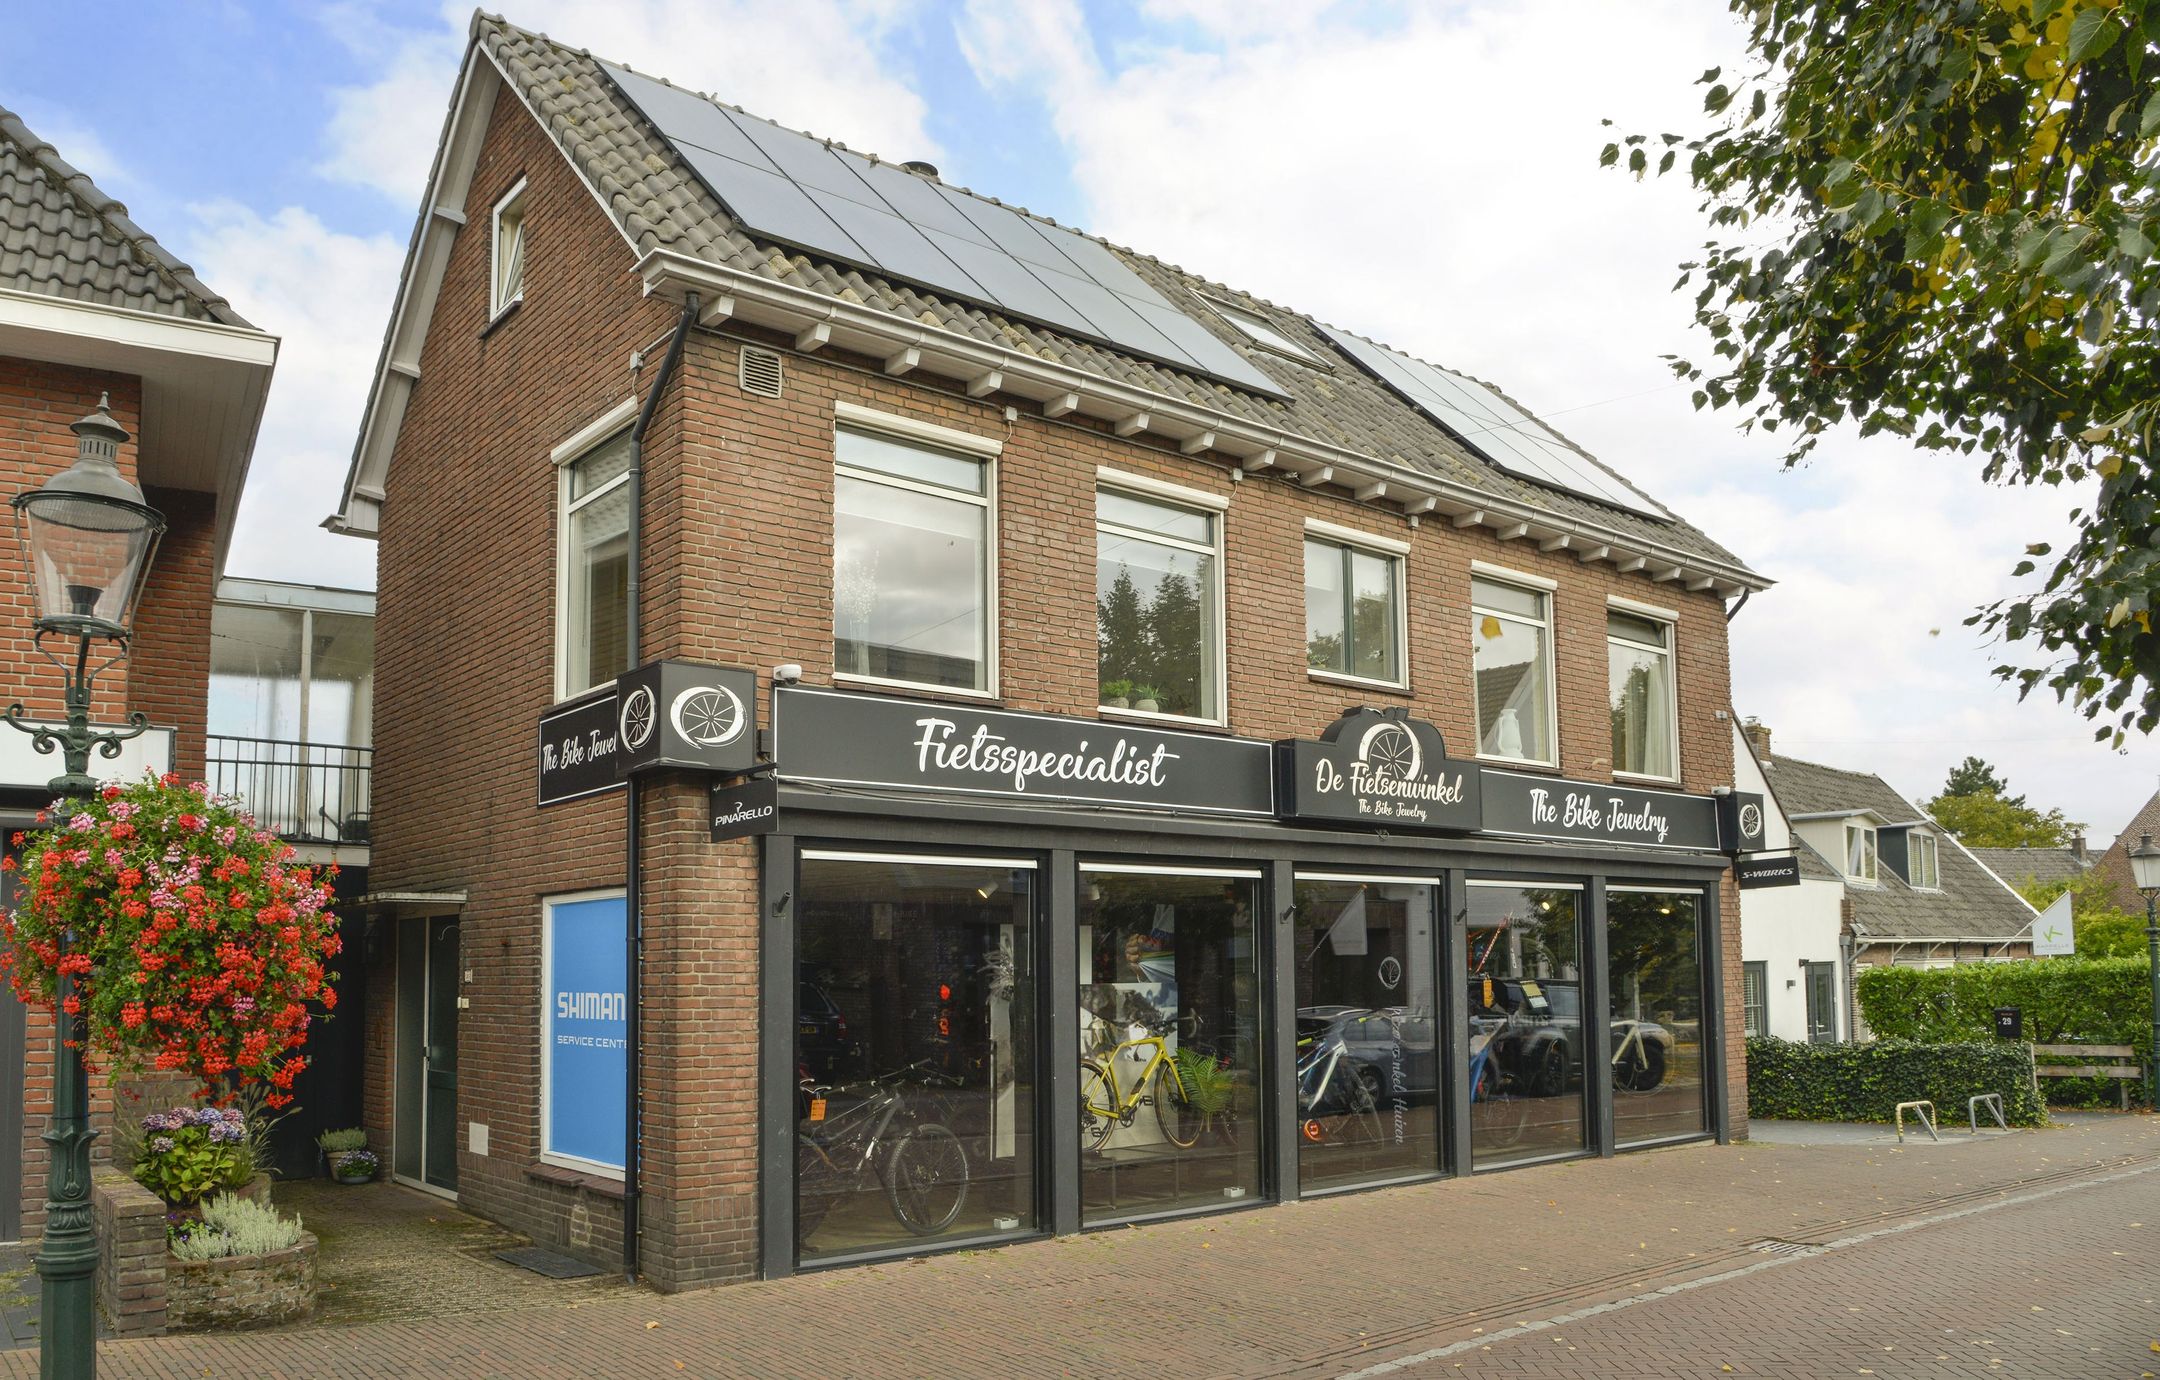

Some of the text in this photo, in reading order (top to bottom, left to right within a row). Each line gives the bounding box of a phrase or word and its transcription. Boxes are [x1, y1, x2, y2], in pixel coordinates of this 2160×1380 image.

[543, 729, 617, 774] The Bike Jewel
[913, 717, 1181, 792] Fietsspecialist
[1315, 758, 1464, 805] De Fietsenwinkel
[715, 804, 773, 827] PINARELLO
[1358, 798, 1428, 823] The Bike Jewelry
[1530, 788, 1669, 843] The Bike Jewelry
[1741, 867, 1794, 879] S-WORKS
[558, 992, 625, 1021] SHIMAN
[557, 1035, 627, 1049] SERVICE CENT
